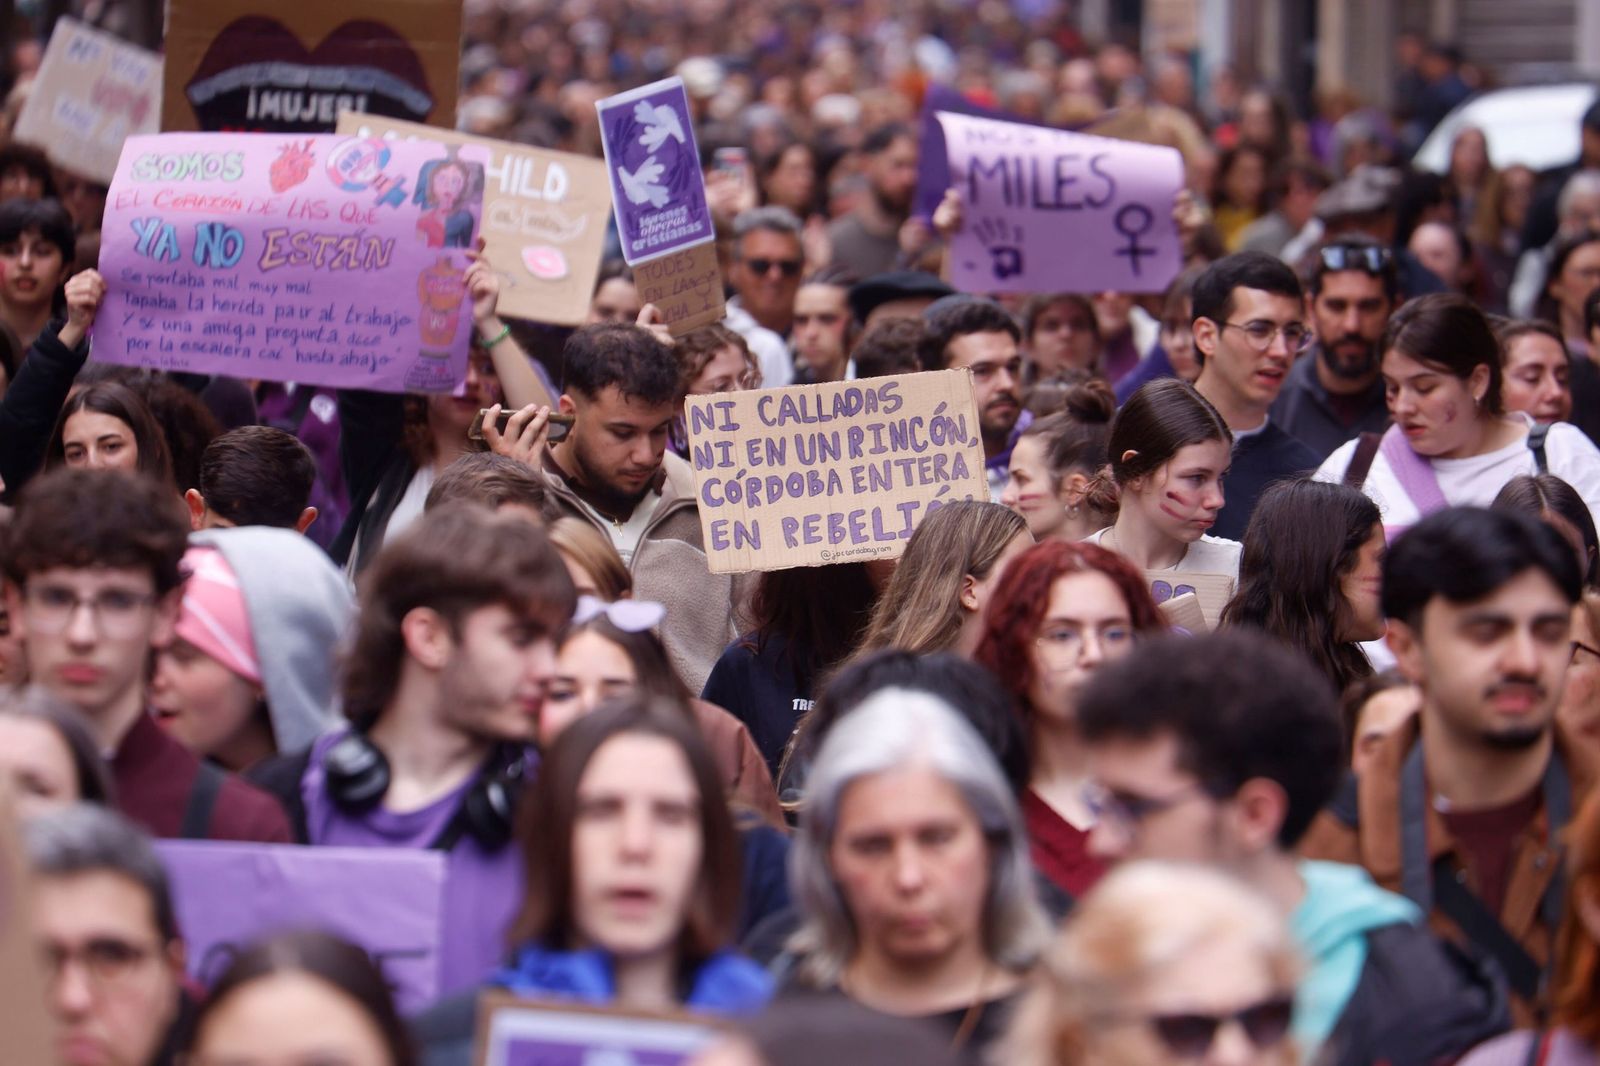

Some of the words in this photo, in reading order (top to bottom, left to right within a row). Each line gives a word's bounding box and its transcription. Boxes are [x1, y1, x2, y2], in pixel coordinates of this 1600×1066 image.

[131, 152, 245, 182] SOMOS
[968, 152, 1117, 210] MILES
[116, 189, 143, 211] EL
[247, 198, 277, 215] DE
[288, 200, 329, 221] LAS
[632, 221, 702, 252] cristianas
[641, 215, 687, 238] obreras
[130, 216, 181, 264] YA
[192, 221, 245, 269] NO
[257, 226, 396, 273] ESTÁN
[637, 249, 695, 280] TODES
[147, 269, 206, 289] portaba
[213, 274, 239, 290] mal
[249, 281, 278, 297] muy
[286, 280, 311, 295] mal
[644, 286, 663, 303] EN
[123, 290, 177, 311] Tapaba
[187, 291, 204, 312] la
[212, 293, 264, 316] herida
[319, 302, 335, 322] al
[345, 303, 412, 336] trabajo
[162, 319, 192, 333] una
[202, 321, 256, 344] amiga
[160, 335, 174, 352] la
[180, 341, 251, 358] escalera
[295, 349, 334, 364] hasta
[691, 401, 740, 435] NI
[757, 381, 903, 427] CALLADAS
[694, 440, 735, 471] NI
[746, 436, 787, 467] EN
[794, 430, 841, 466] UN
[847, 401, 978, 460] RINCÓN,
[702, 468, 843, 509] CÓRDOBA
[850, 452, 970, 495] ENTERA
[710, 519, 761, 551] EN
[781, 485, 974, 549] REBELI
[792, 698, 816, 711] TRE
